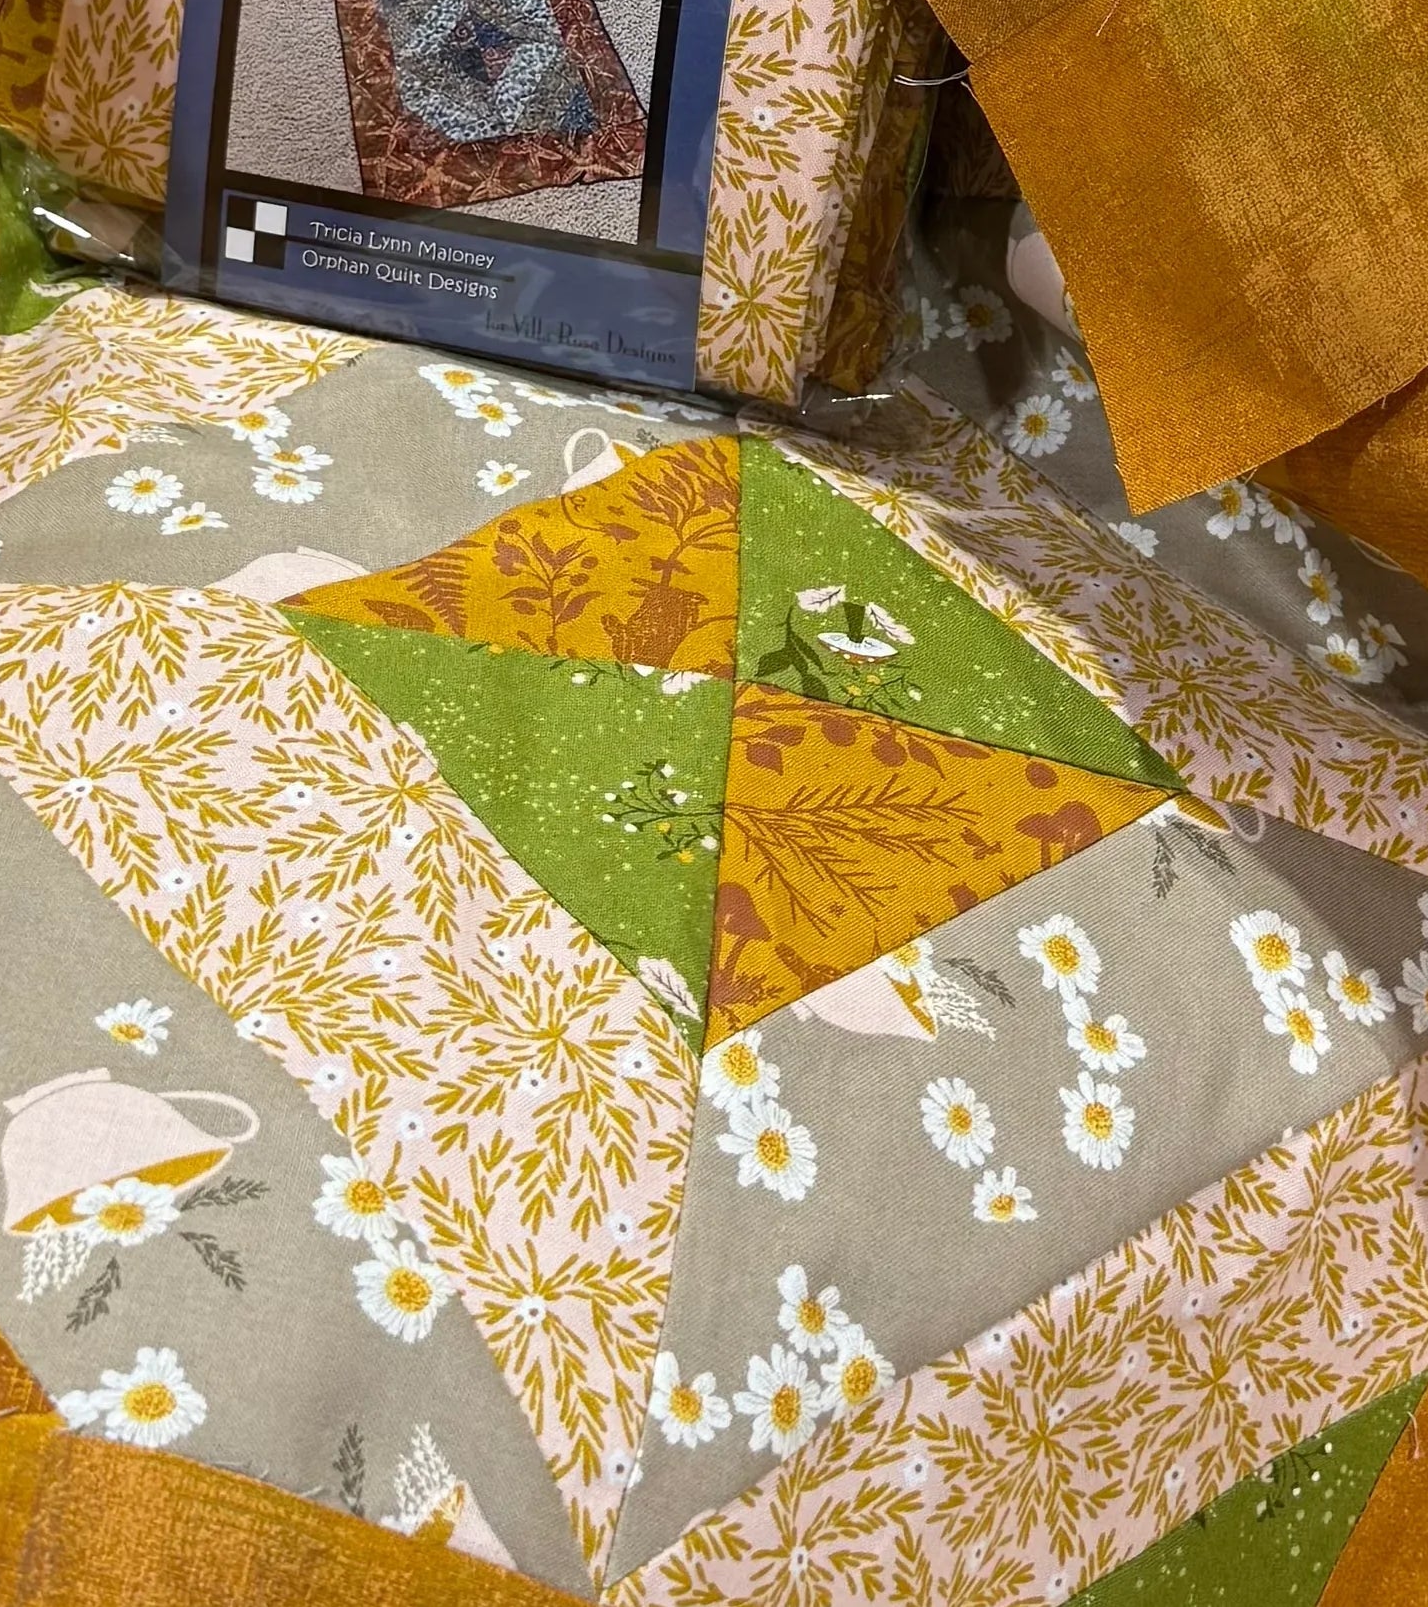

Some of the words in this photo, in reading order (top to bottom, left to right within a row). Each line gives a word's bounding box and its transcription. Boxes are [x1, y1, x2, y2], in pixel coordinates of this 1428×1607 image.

[309, 221, 363, 245] Tricia
[368, 232, 412, 255] Lynn
[418, 240, 495, 269] Maloney
[302, 249, 370, 275] Orphan
[375, 263, 422, 285] Quilt
[428, 272, 499, 300] Designs
[606, 330, 677, 365] Designs
